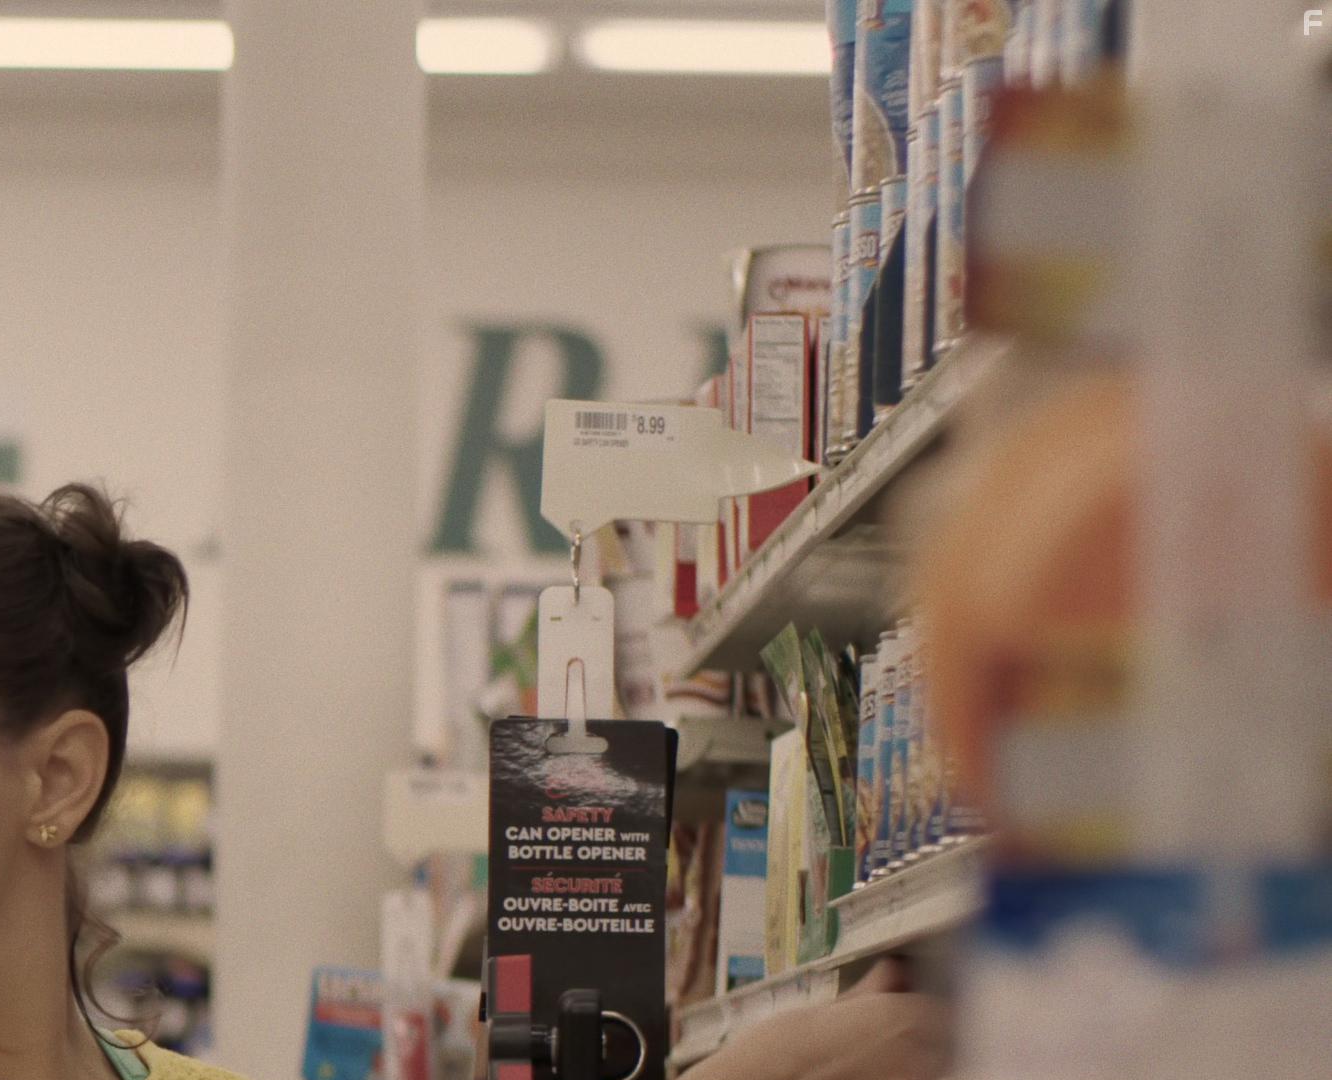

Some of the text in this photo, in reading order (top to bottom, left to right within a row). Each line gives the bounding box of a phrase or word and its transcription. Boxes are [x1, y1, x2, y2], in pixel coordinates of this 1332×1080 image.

[541, 806, 614, 823] SAFETY
[505, 826, 650, 843] CAN OPENER WITH
[508, 845, 647, 861] BOTTLE OPENER
[531, 872, 624, 894] SÉCURITÉ
[503, 896, 651, 913] OUVRE-BOITE AVEC
[498, 916, 655, 933] OUVRE-BOUTEILLE
